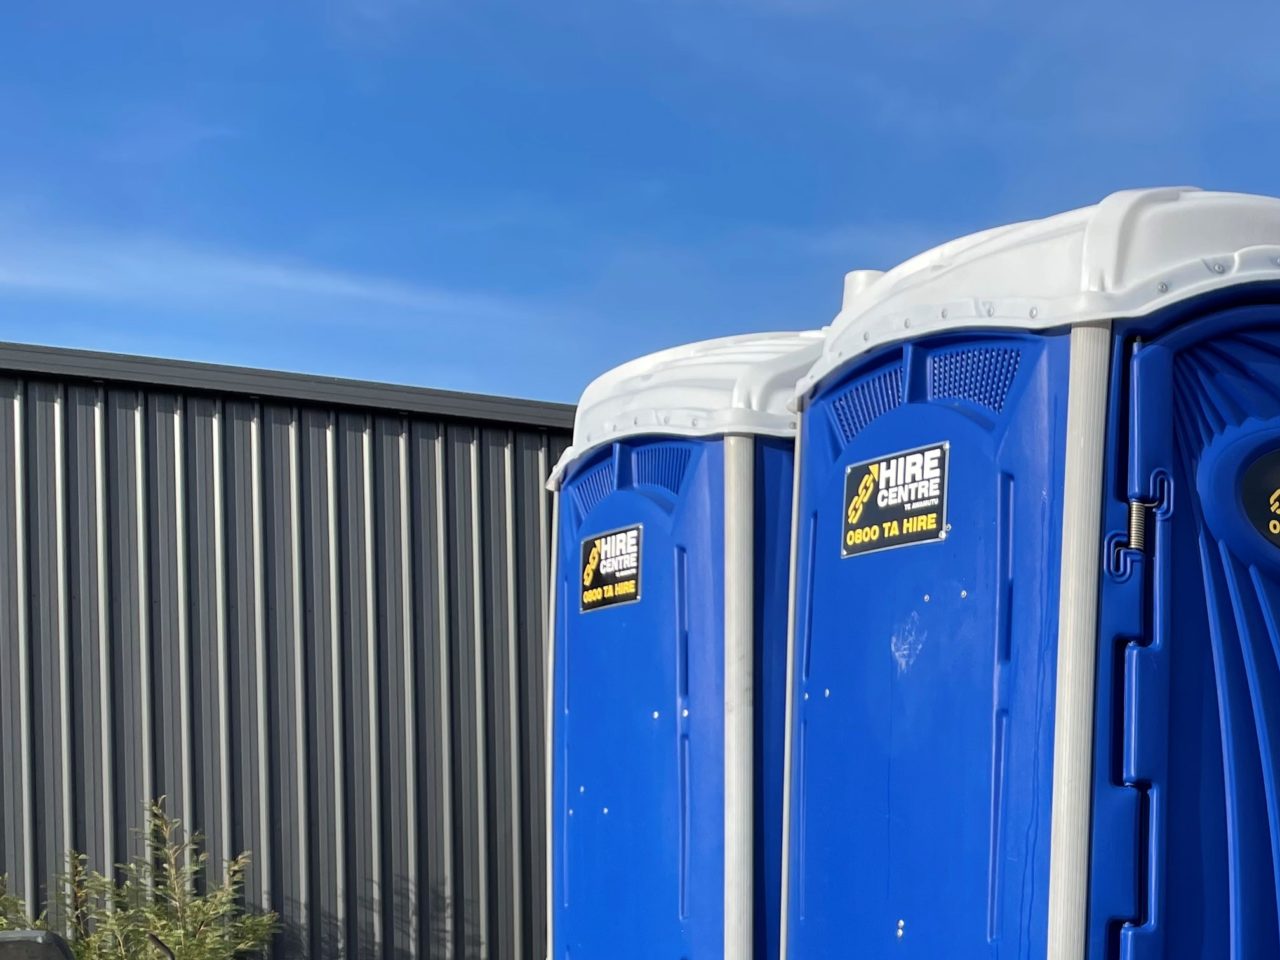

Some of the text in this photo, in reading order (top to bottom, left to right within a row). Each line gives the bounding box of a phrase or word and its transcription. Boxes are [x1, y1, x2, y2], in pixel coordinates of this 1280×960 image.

[879, 448, 941, 489] HIRE
[877, 478, 940, 507] CENTRE
[846, 513, 937, 545] 0800 TA HIRE
[600, 529, 638, 560] HIRE
[600, 552, 637, 575] CENTRE
[603, 584, 614, 598] TA
[614, 579, 636, 596] HIRE
